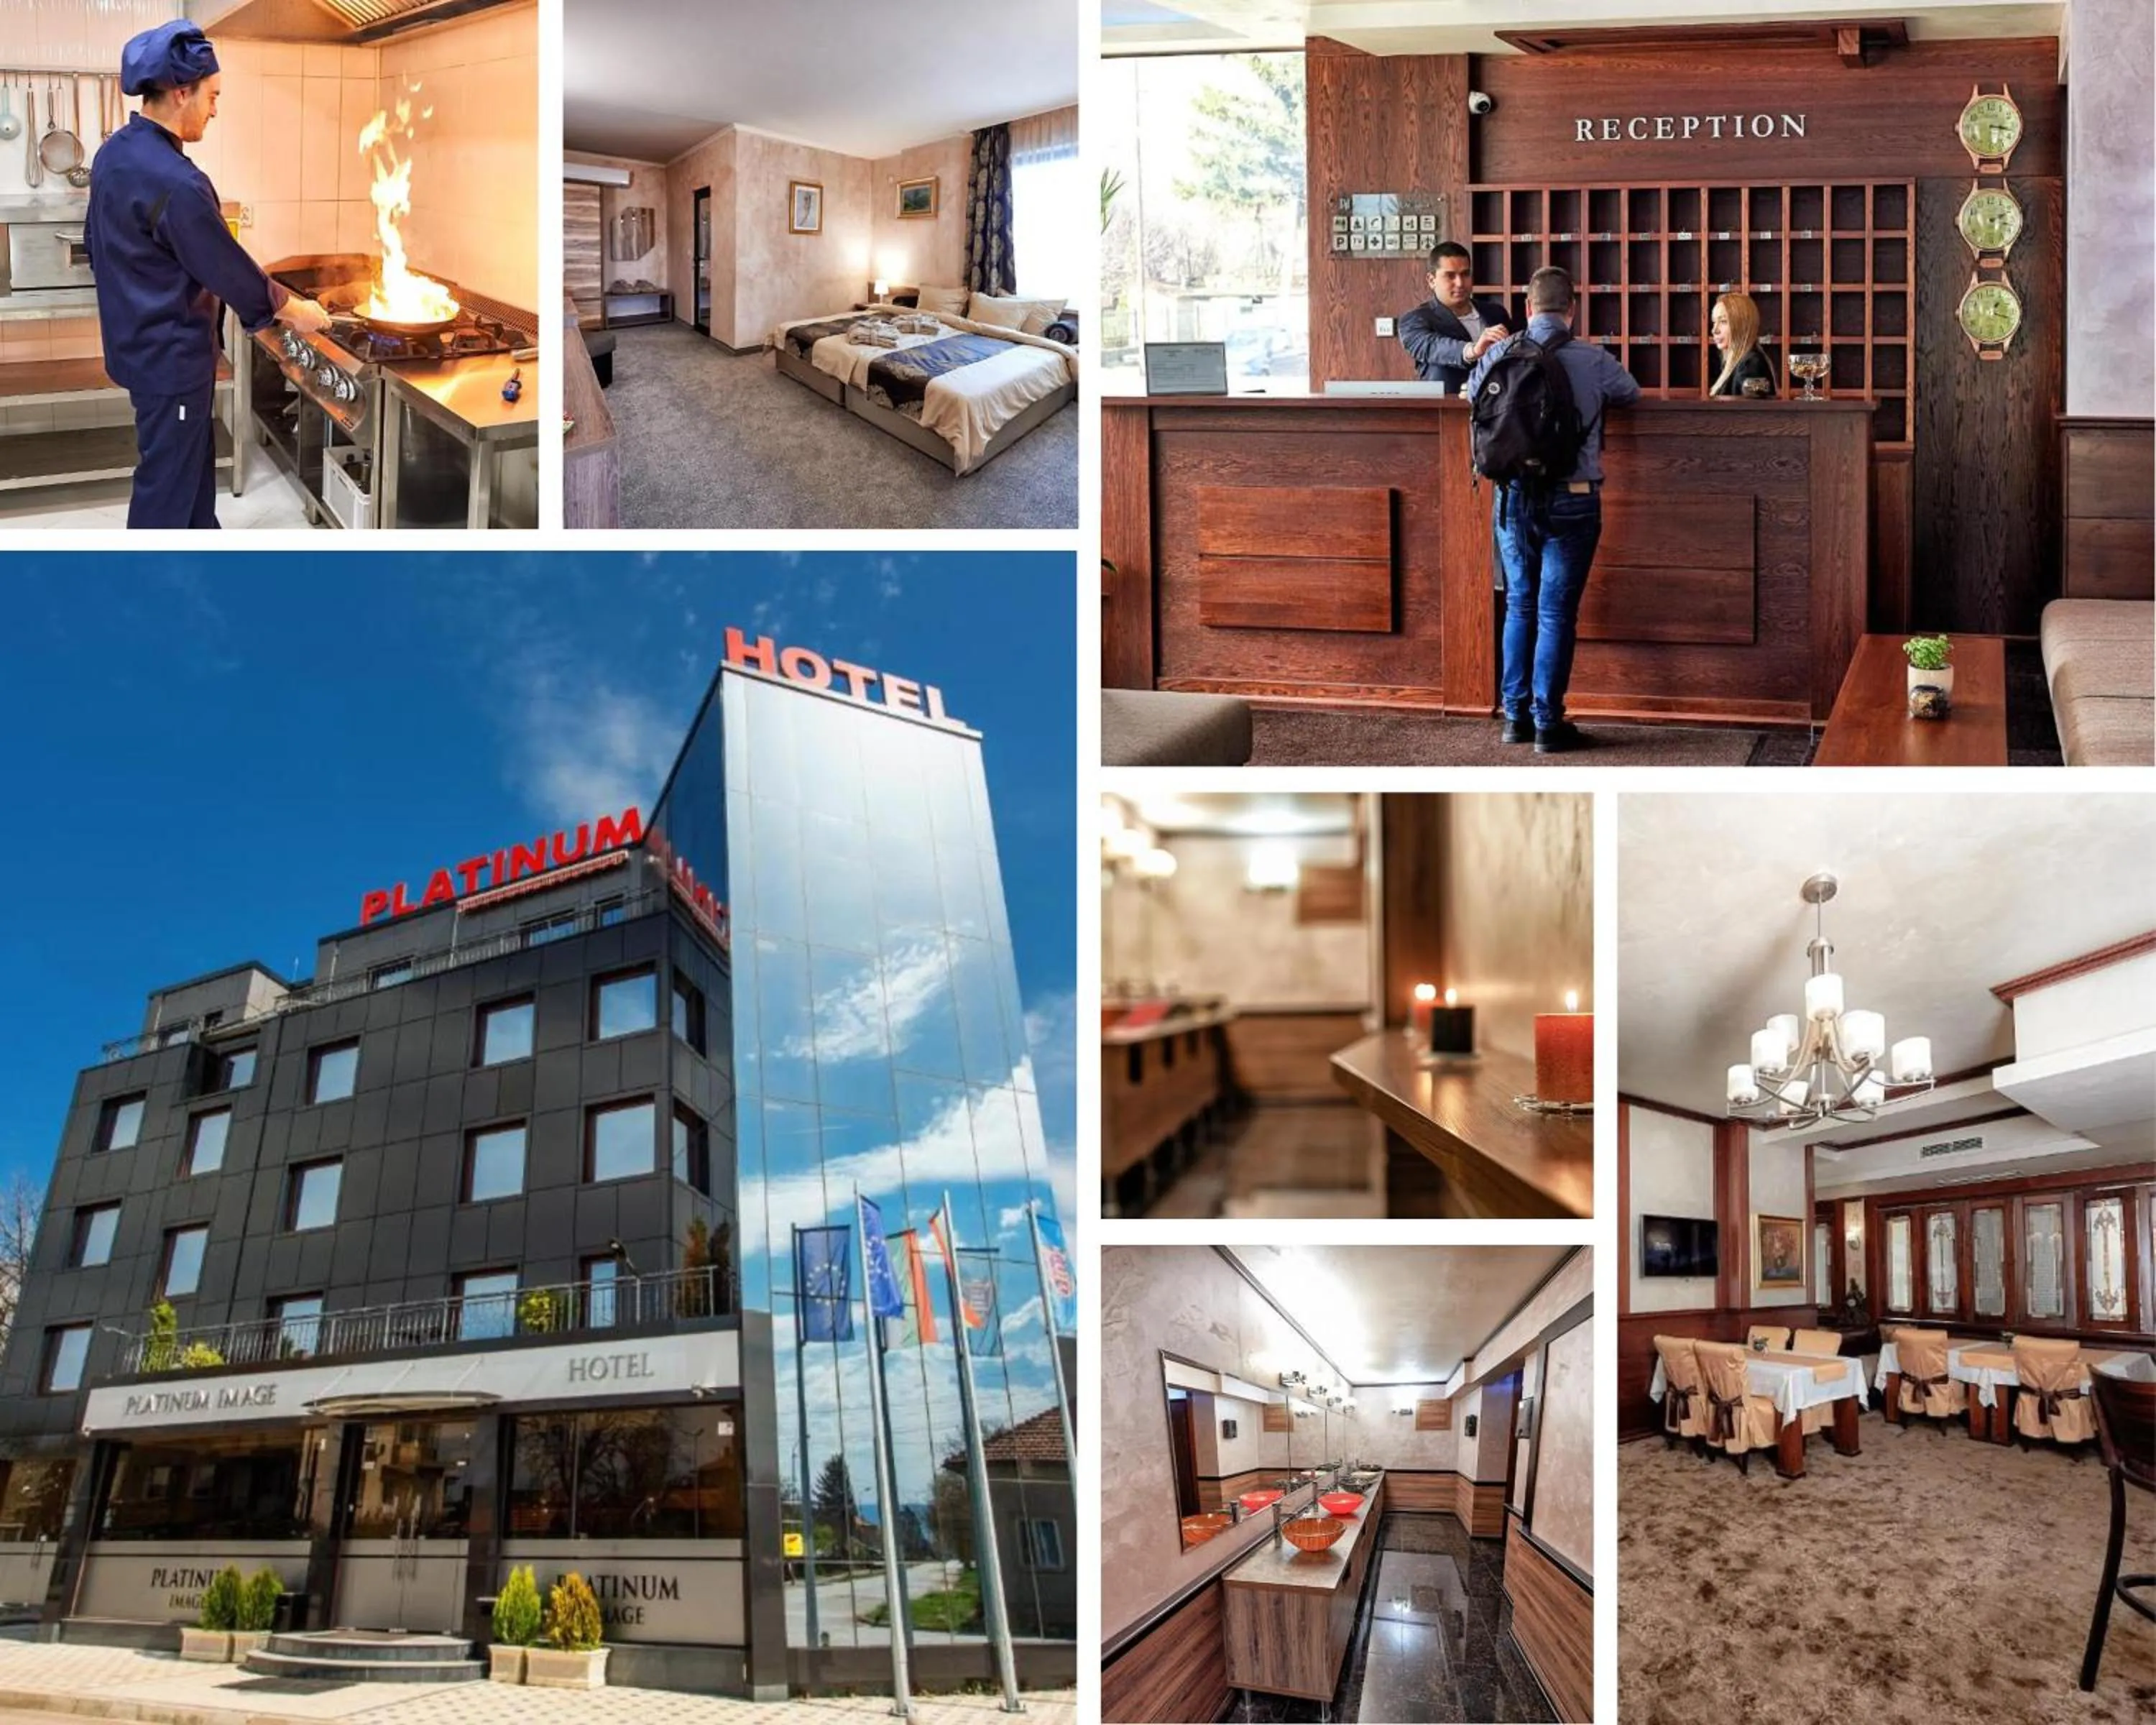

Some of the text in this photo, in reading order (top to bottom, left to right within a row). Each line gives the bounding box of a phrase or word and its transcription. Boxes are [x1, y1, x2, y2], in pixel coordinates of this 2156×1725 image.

[1575, 114, 1806, 142] RECEPTION
[724, 625, 968, 730] HOTEL
[360, 806, 642, 924] PLATINUM
[568, 1352, 655, 1381] HOTEL
[124, 1384, 278, 1416] PLATINUM IMAGE
